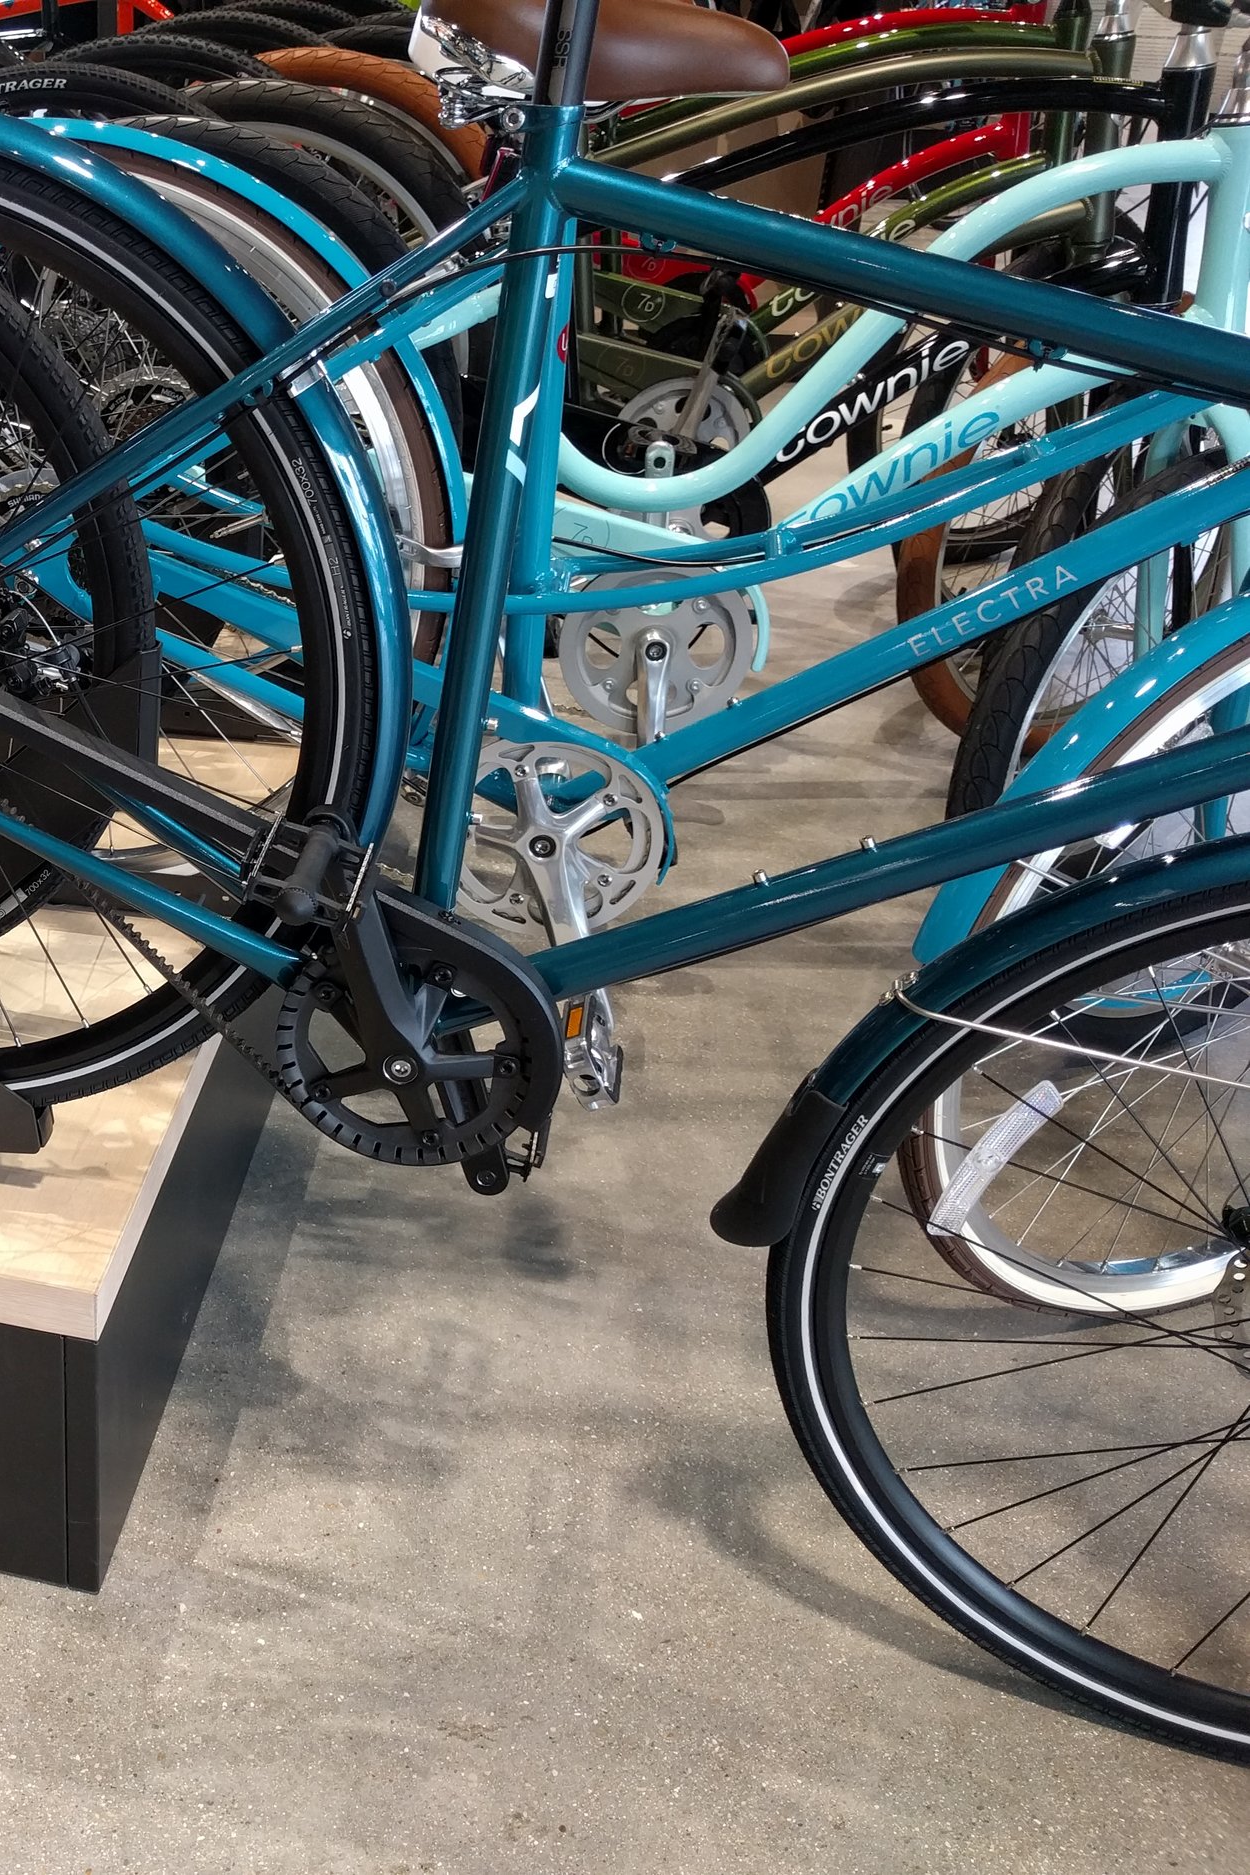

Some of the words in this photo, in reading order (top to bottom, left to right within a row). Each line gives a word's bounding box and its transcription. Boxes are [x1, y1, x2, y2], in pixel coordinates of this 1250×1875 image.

[552, 29, 572, 69] SSR
[328, 555, 342, 577] H2
[906, 564, 1079, 657] ELECTRA
[24, 869, 51, 897] 700x32
[815, 1113, 870, 1201] BONTRAGER
